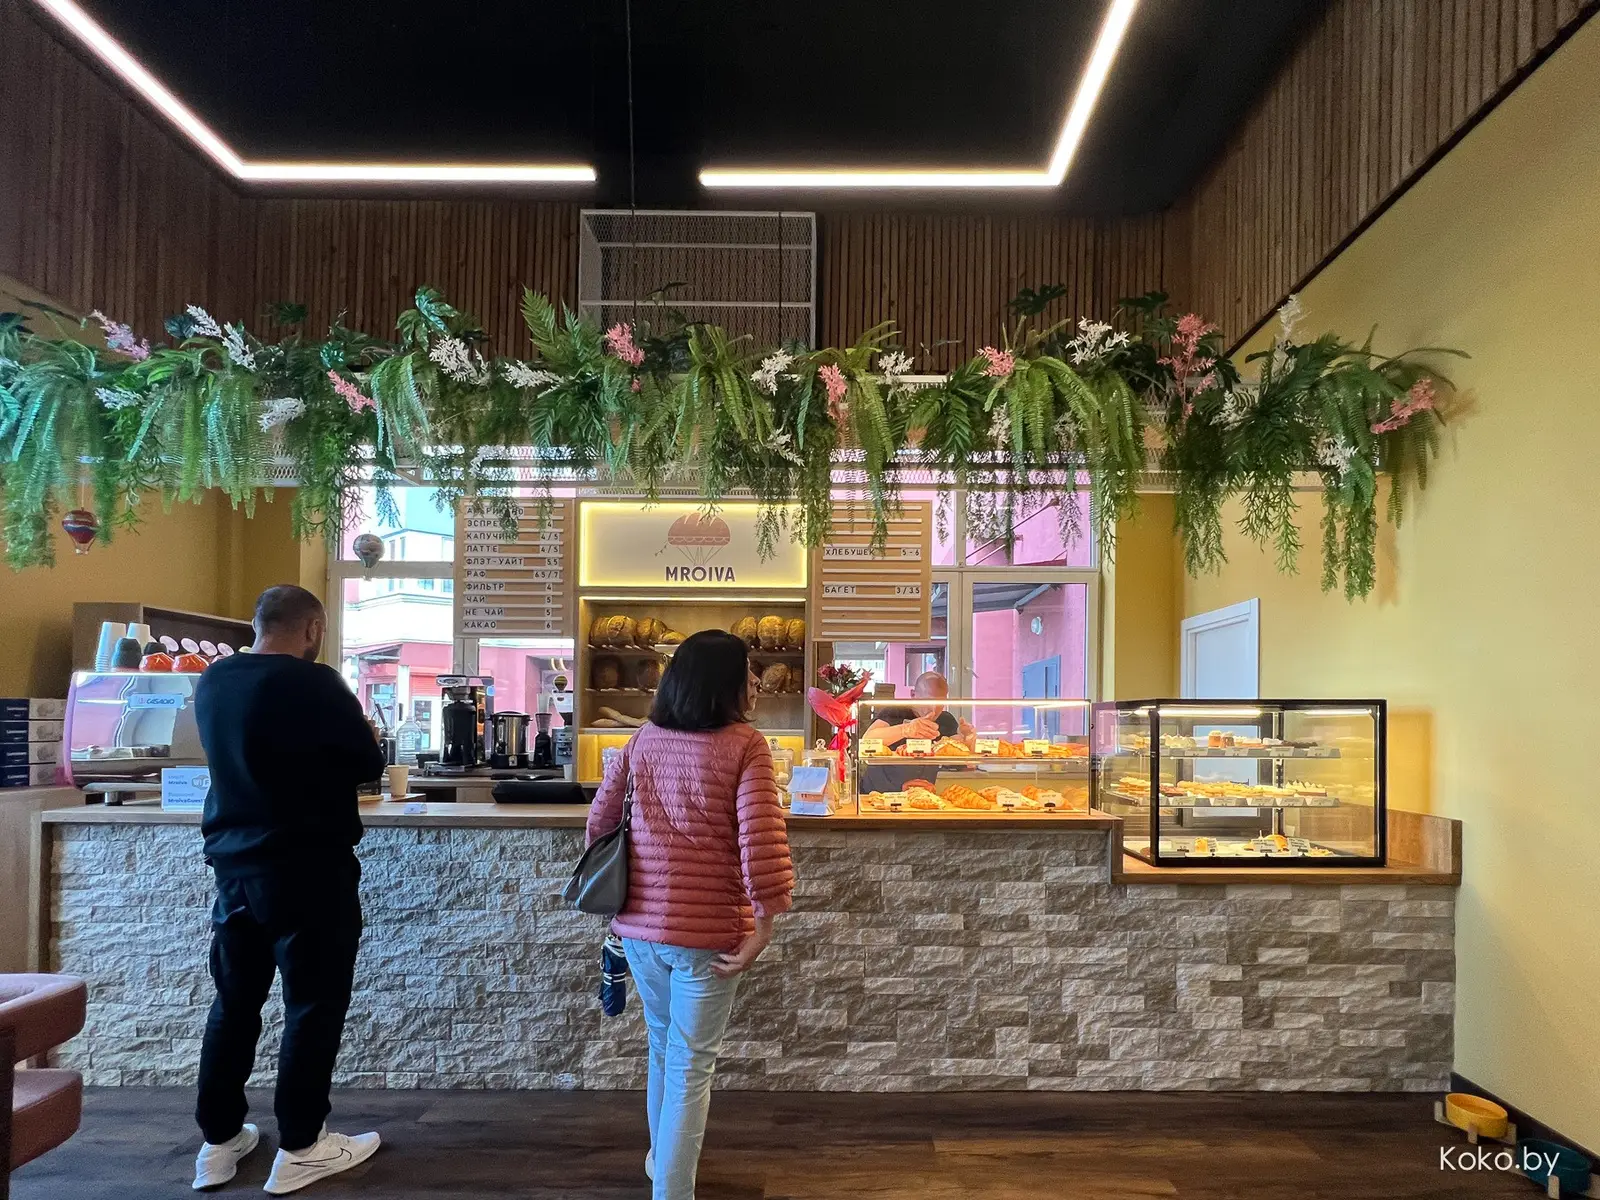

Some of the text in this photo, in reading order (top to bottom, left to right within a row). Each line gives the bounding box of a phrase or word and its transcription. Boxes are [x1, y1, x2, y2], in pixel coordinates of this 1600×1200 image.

[467, 507, 524, 516] АРИНО
[541, 532, 558, 540] 4/5
[541, 545, 558, 553] 4/5
[825, 548, 875, 556] ХЛЕБУШЕК
[666, 566, 735, 582] MROIVA
[825, 586, 856, 594] БАГЕТ
[466, 595, 485, 603] ЧАЙ
